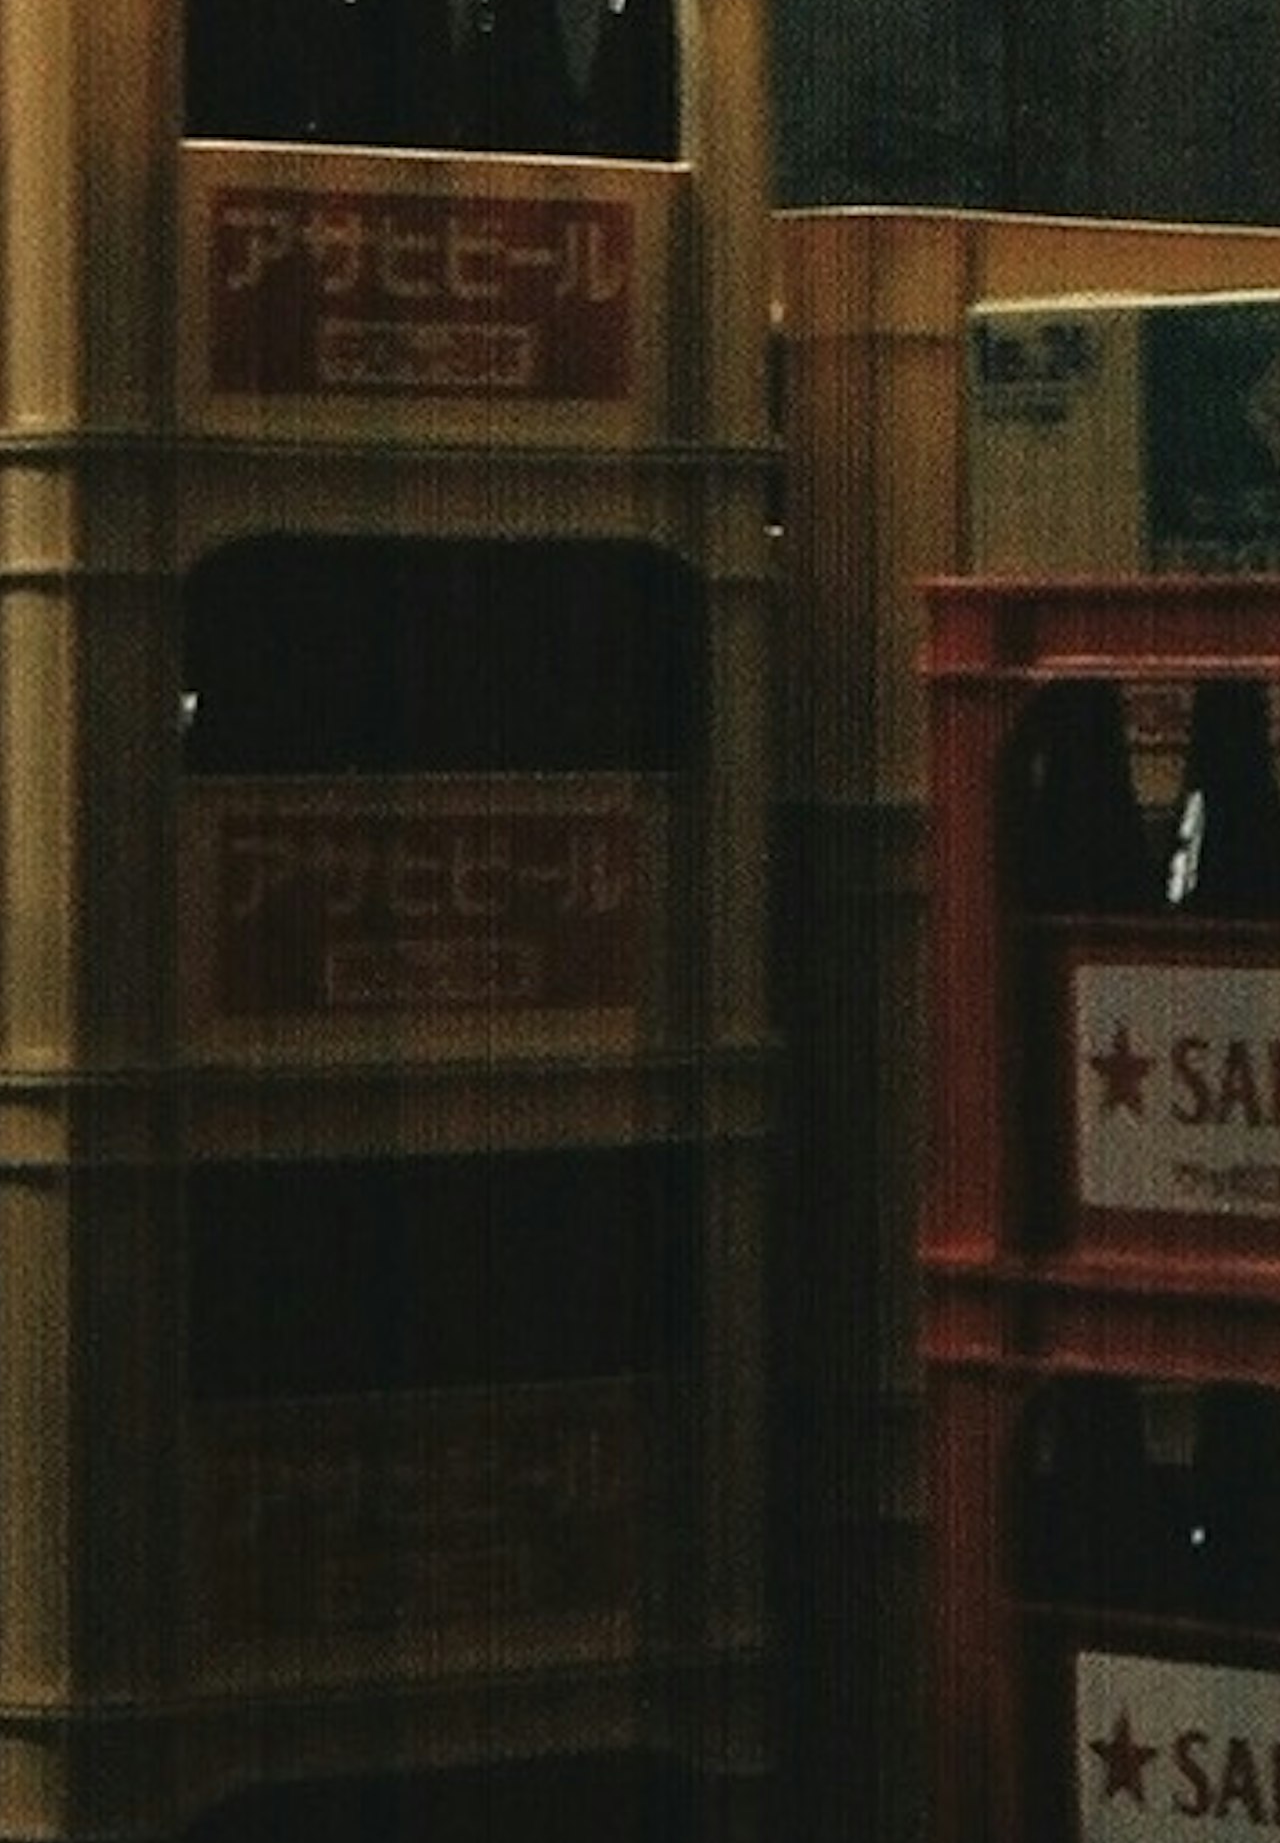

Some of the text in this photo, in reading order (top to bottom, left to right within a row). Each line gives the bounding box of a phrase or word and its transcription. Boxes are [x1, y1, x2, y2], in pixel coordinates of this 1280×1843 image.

[222, 204, 622, 303] アサヒビール
